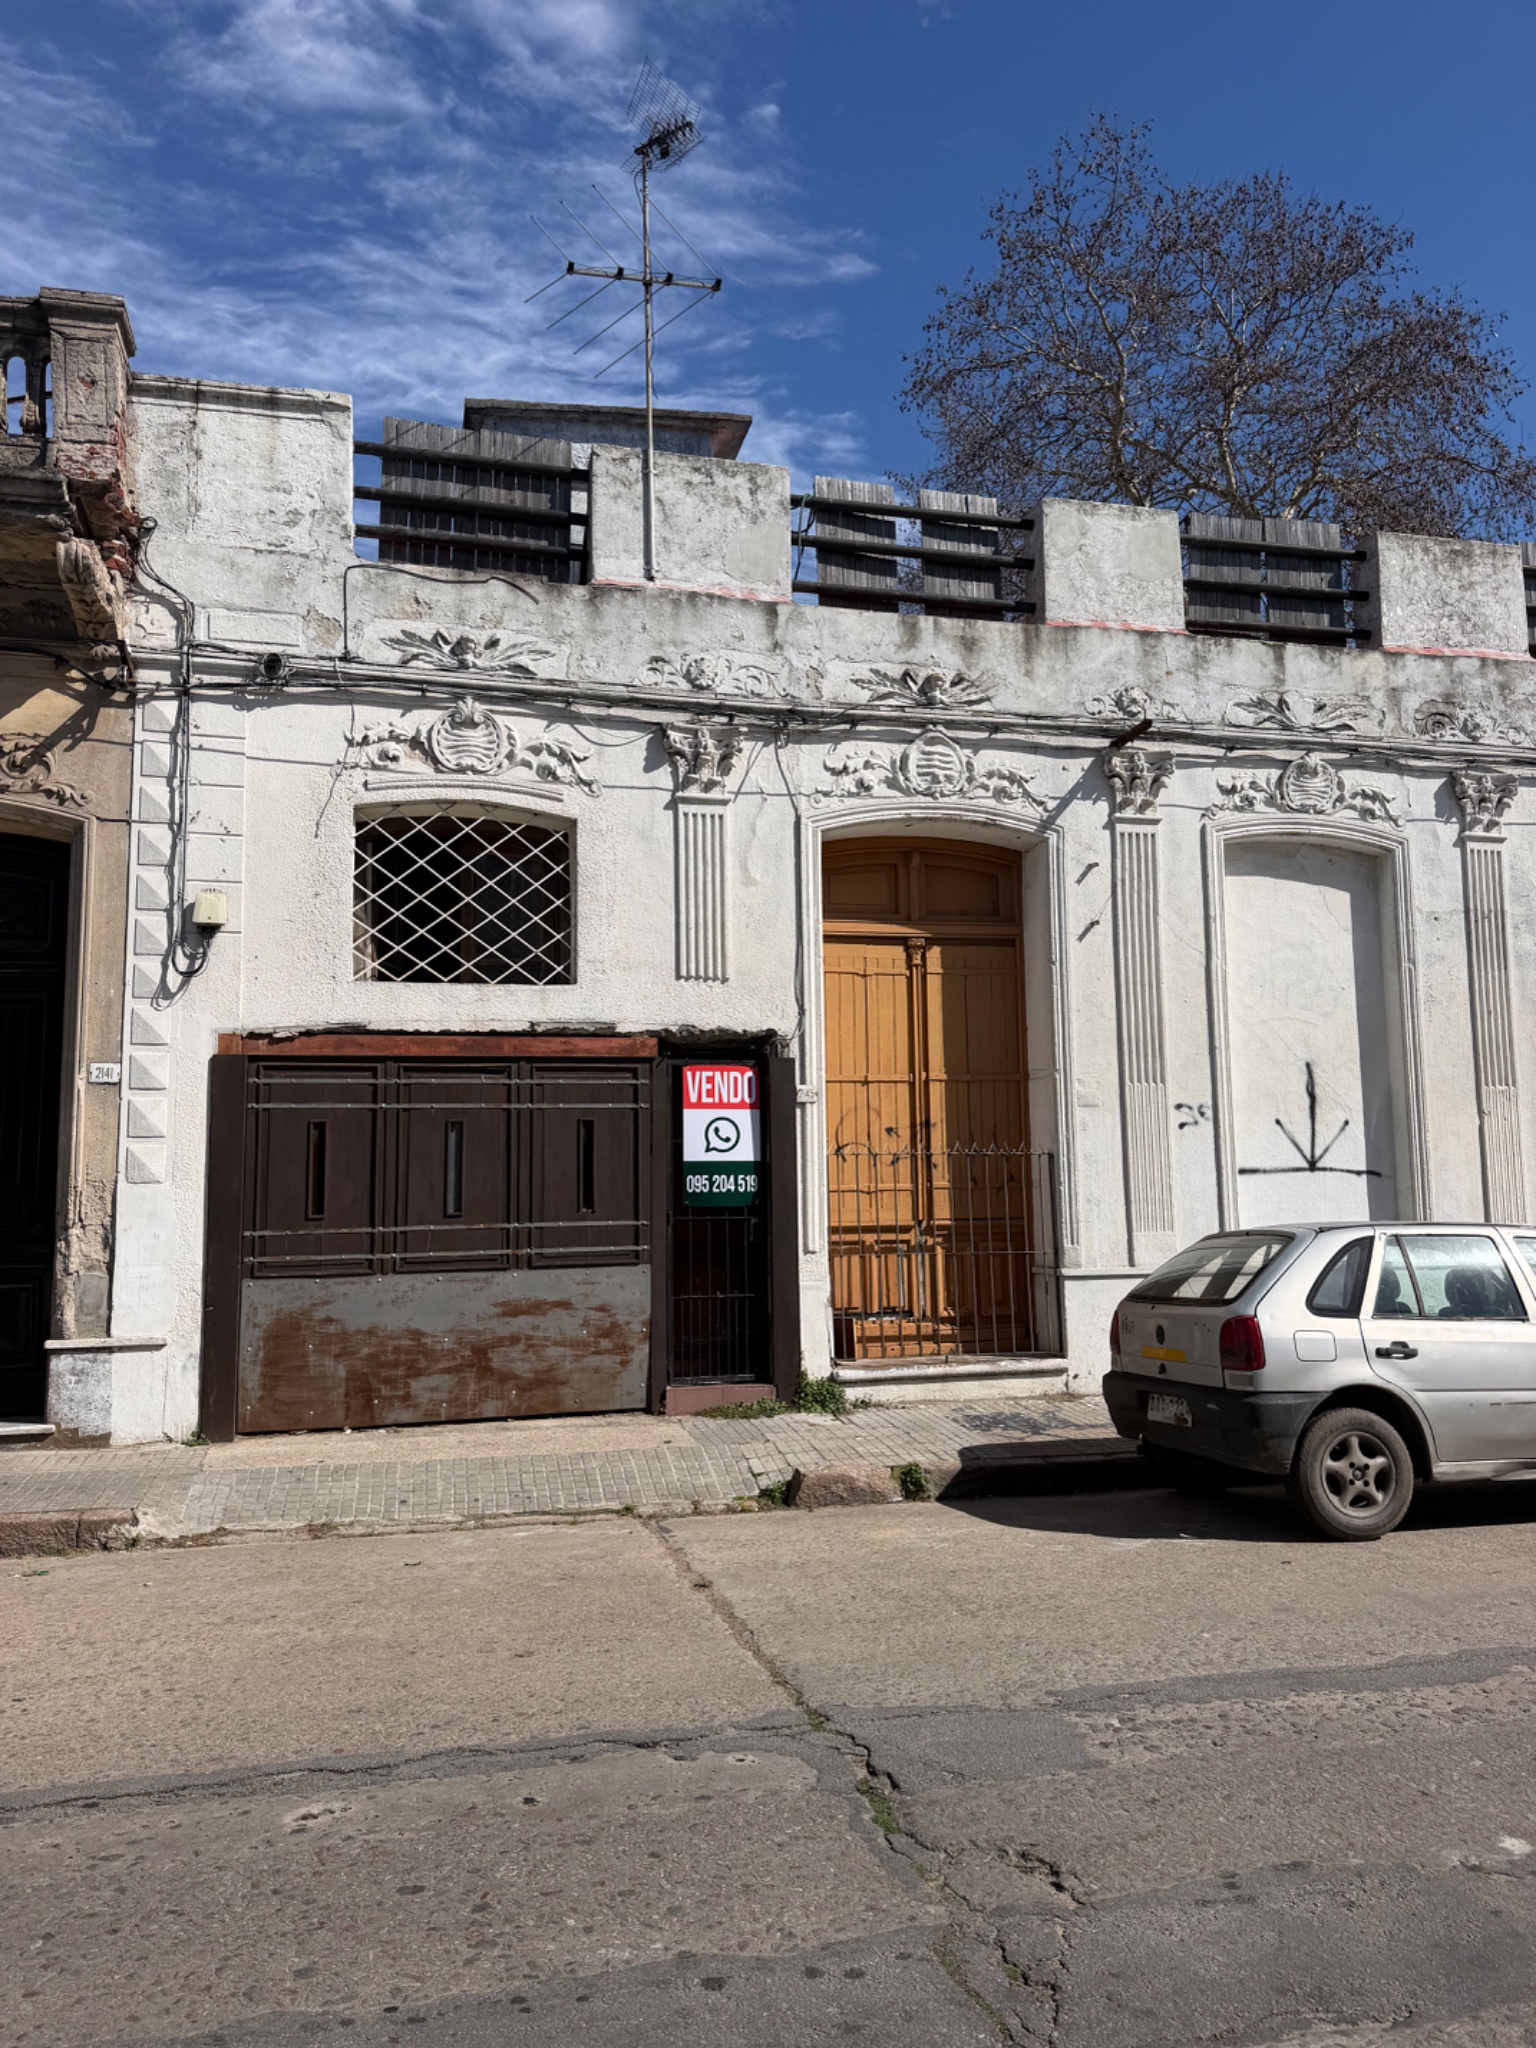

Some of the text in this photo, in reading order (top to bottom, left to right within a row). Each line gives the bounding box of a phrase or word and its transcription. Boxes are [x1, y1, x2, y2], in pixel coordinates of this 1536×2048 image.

[95, 1066, 114, 1080] 2141
[686, 1071, 756, 1104] VENDO
[686, 1174, 758, 1193] 095 204 519
